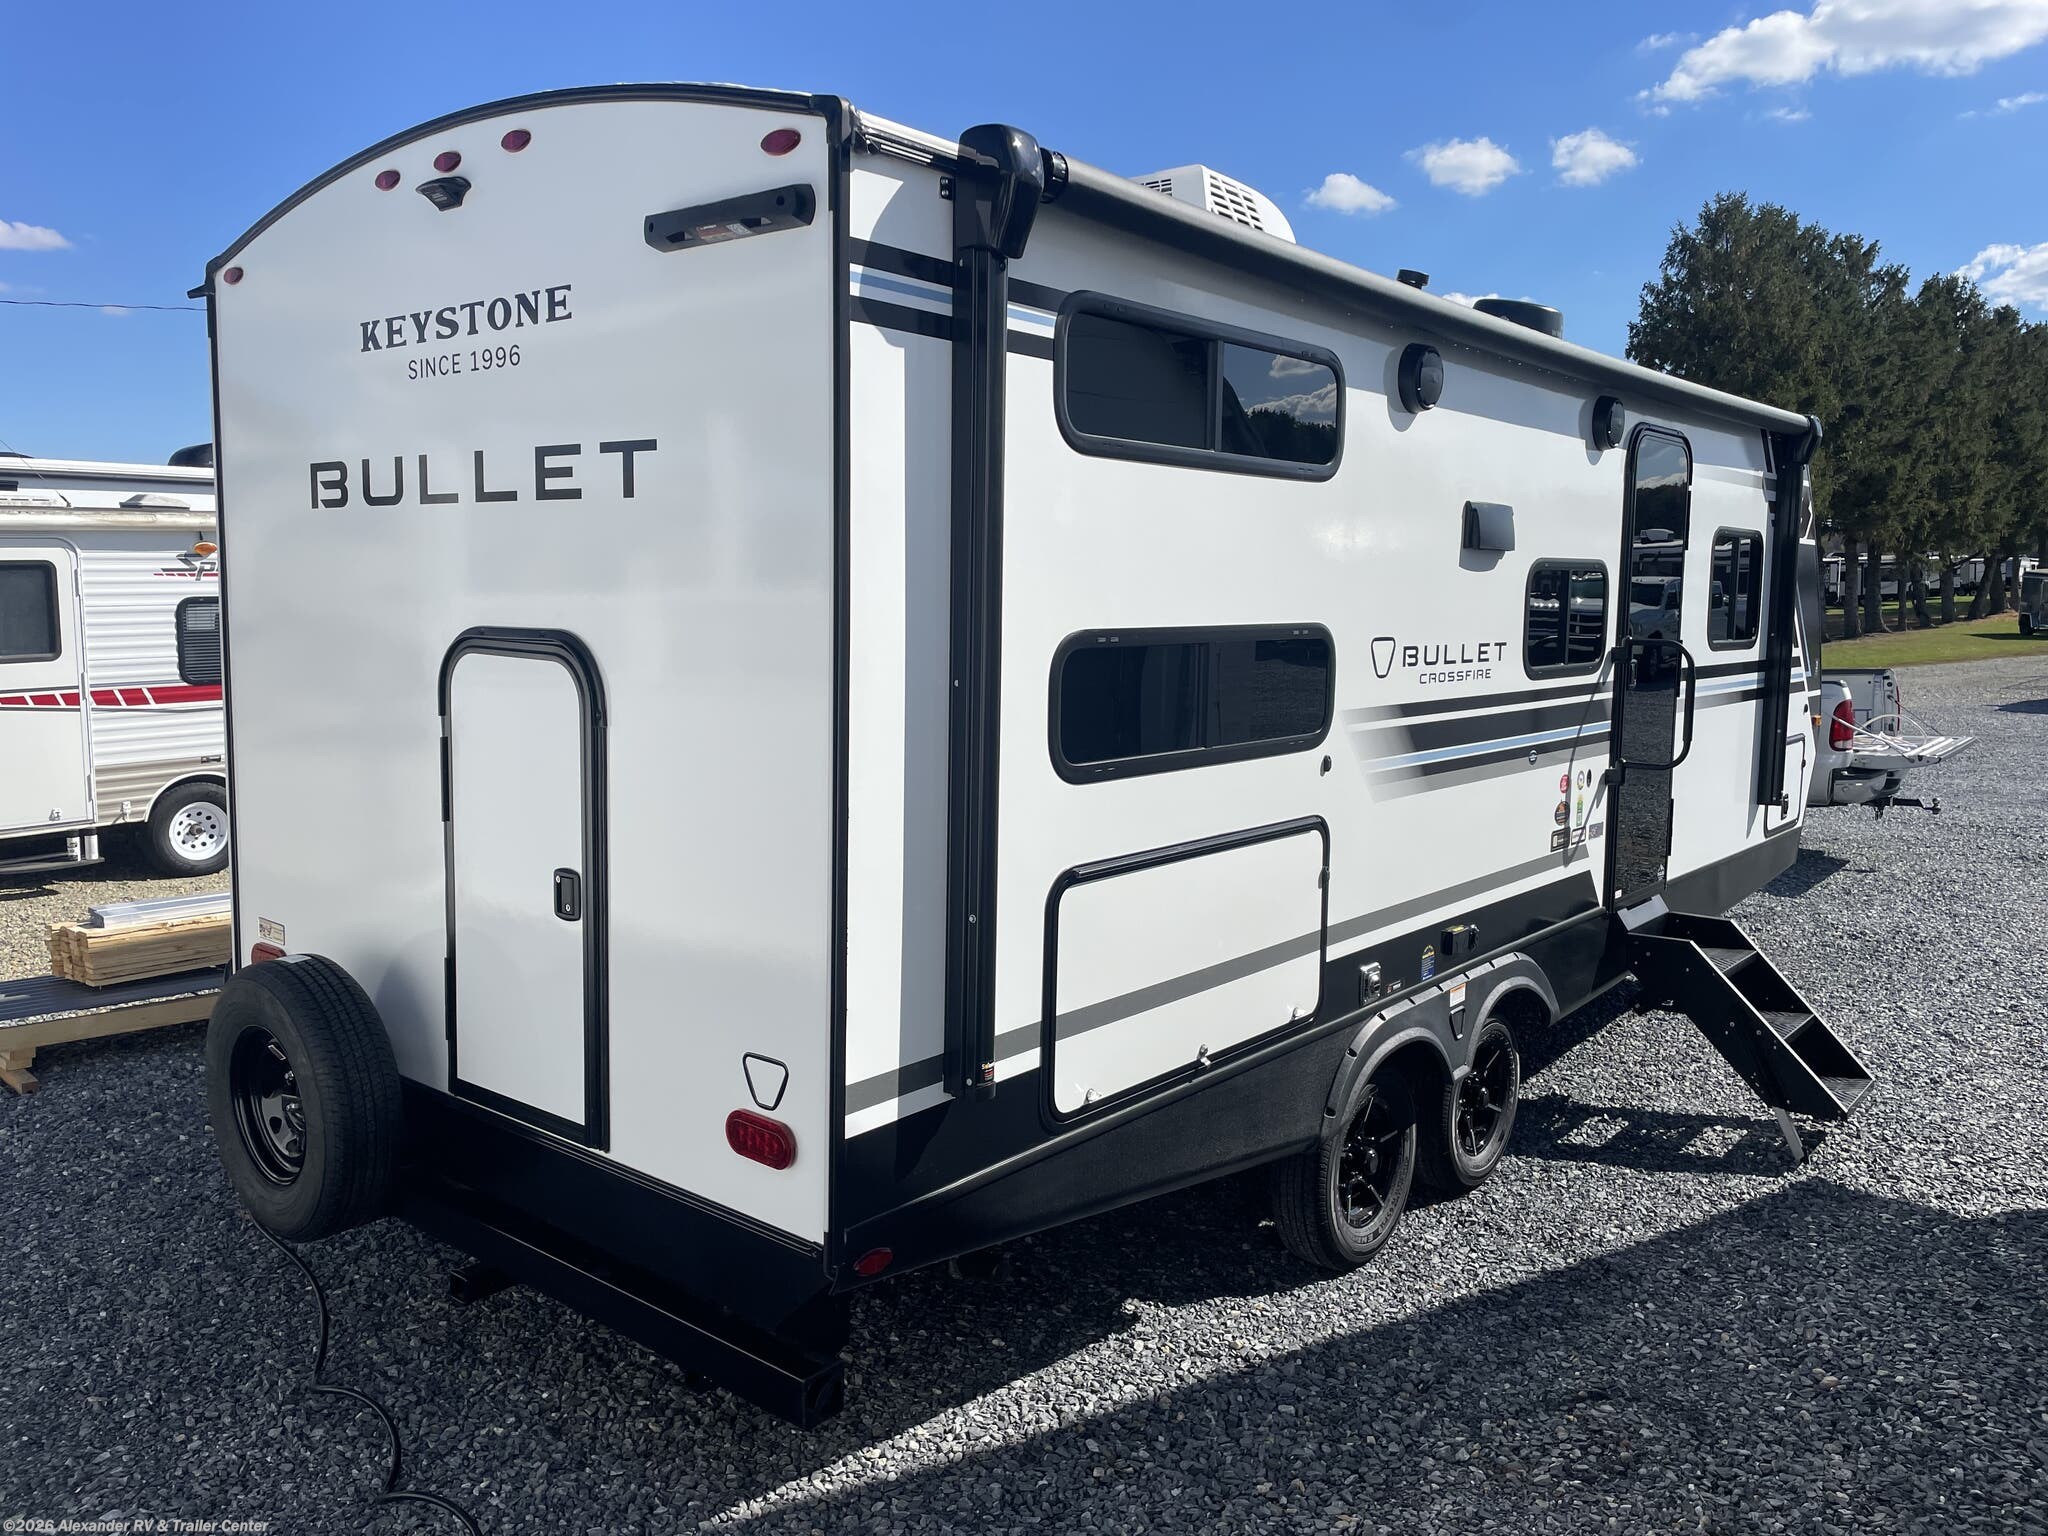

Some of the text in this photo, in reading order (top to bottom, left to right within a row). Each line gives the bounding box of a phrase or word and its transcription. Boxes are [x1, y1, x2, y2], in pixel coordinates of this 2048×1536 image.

[360, 284, 572, 352] KEYSTONE
[408, 344, 521, 380] SINCE 1996
[310, 438, 658, 509] BULLET
[1402, 642, 1507, 667] BULLET
[1419, 669, 1492, 684] CROSSFIRE
